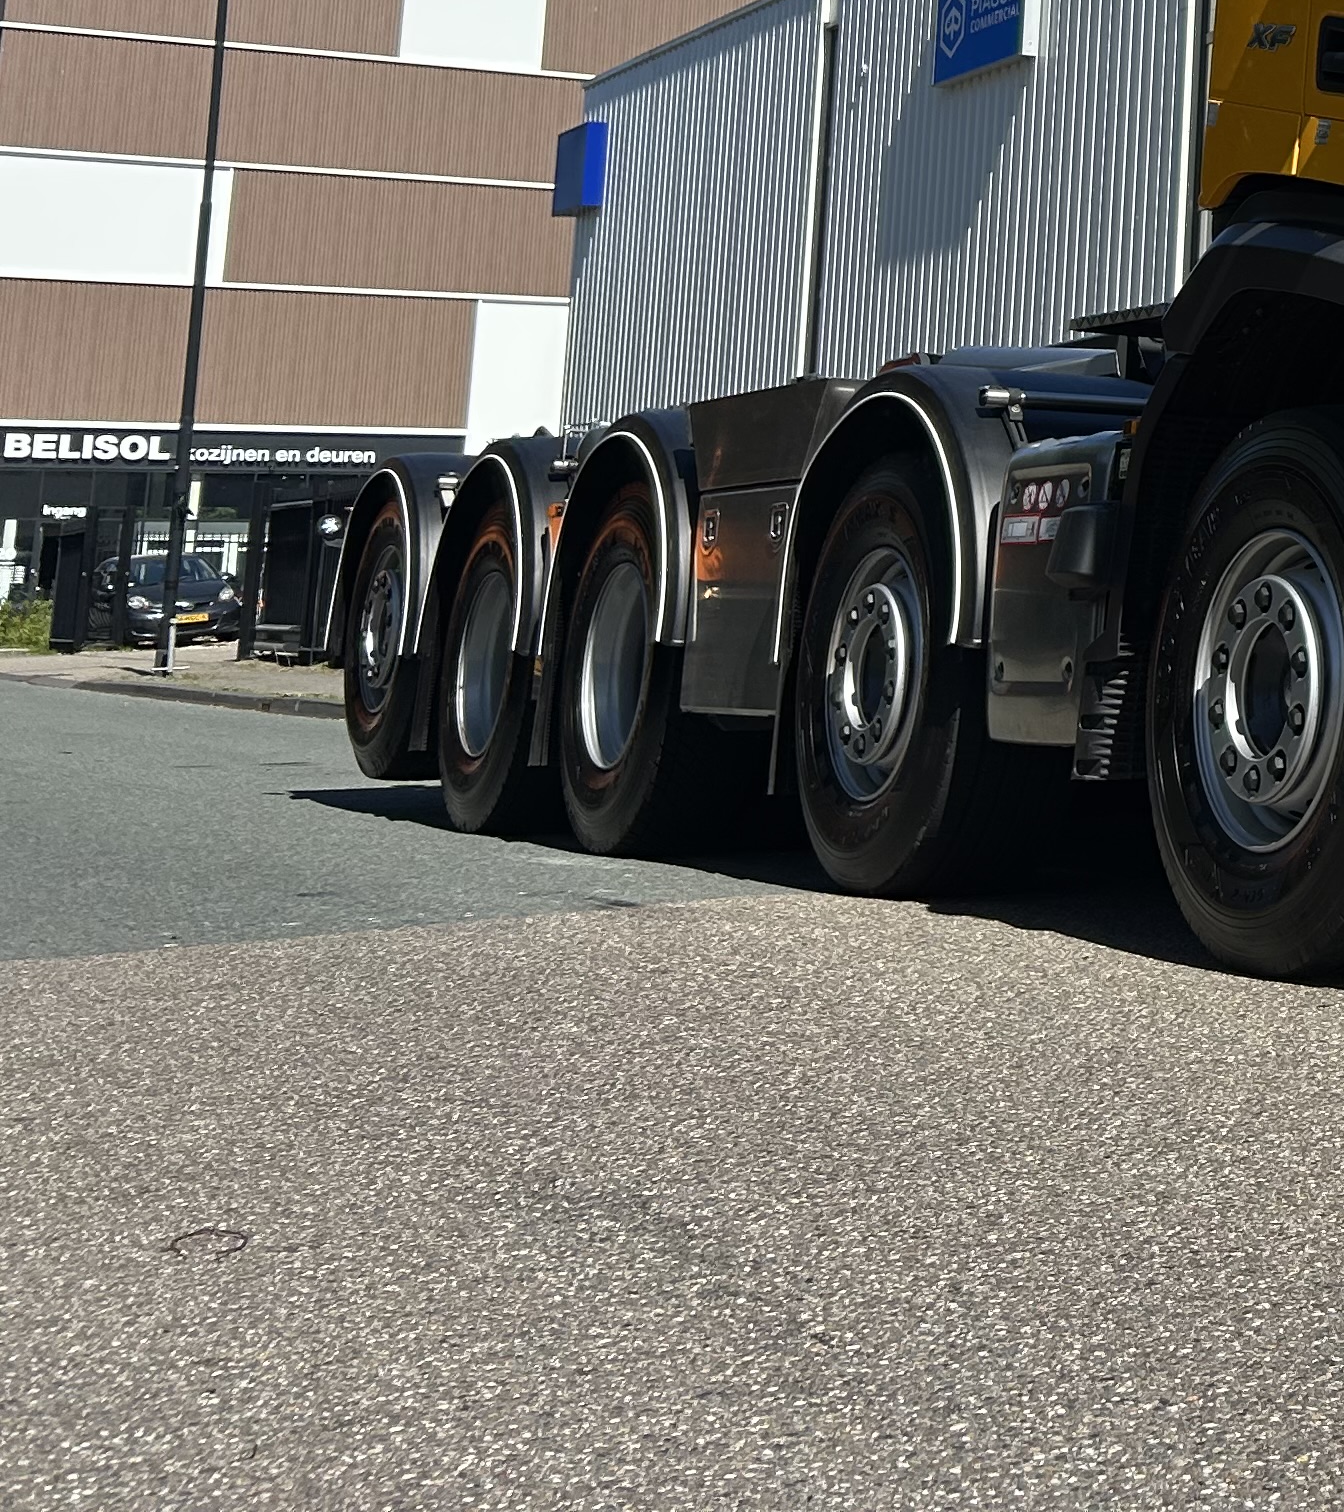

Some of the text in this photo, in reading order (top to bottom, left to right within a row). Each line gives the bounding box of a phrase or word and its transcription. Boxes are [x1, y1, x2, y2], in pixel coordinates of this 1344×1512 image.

[969, 3, 1020, 34] COMMERCIAL
[1246, 22, 1297, 53] XF
[3, 432, 171, 461] BELISOL
[275, 449, 300, 463] en
[306, 446, 376, 464] deuren
